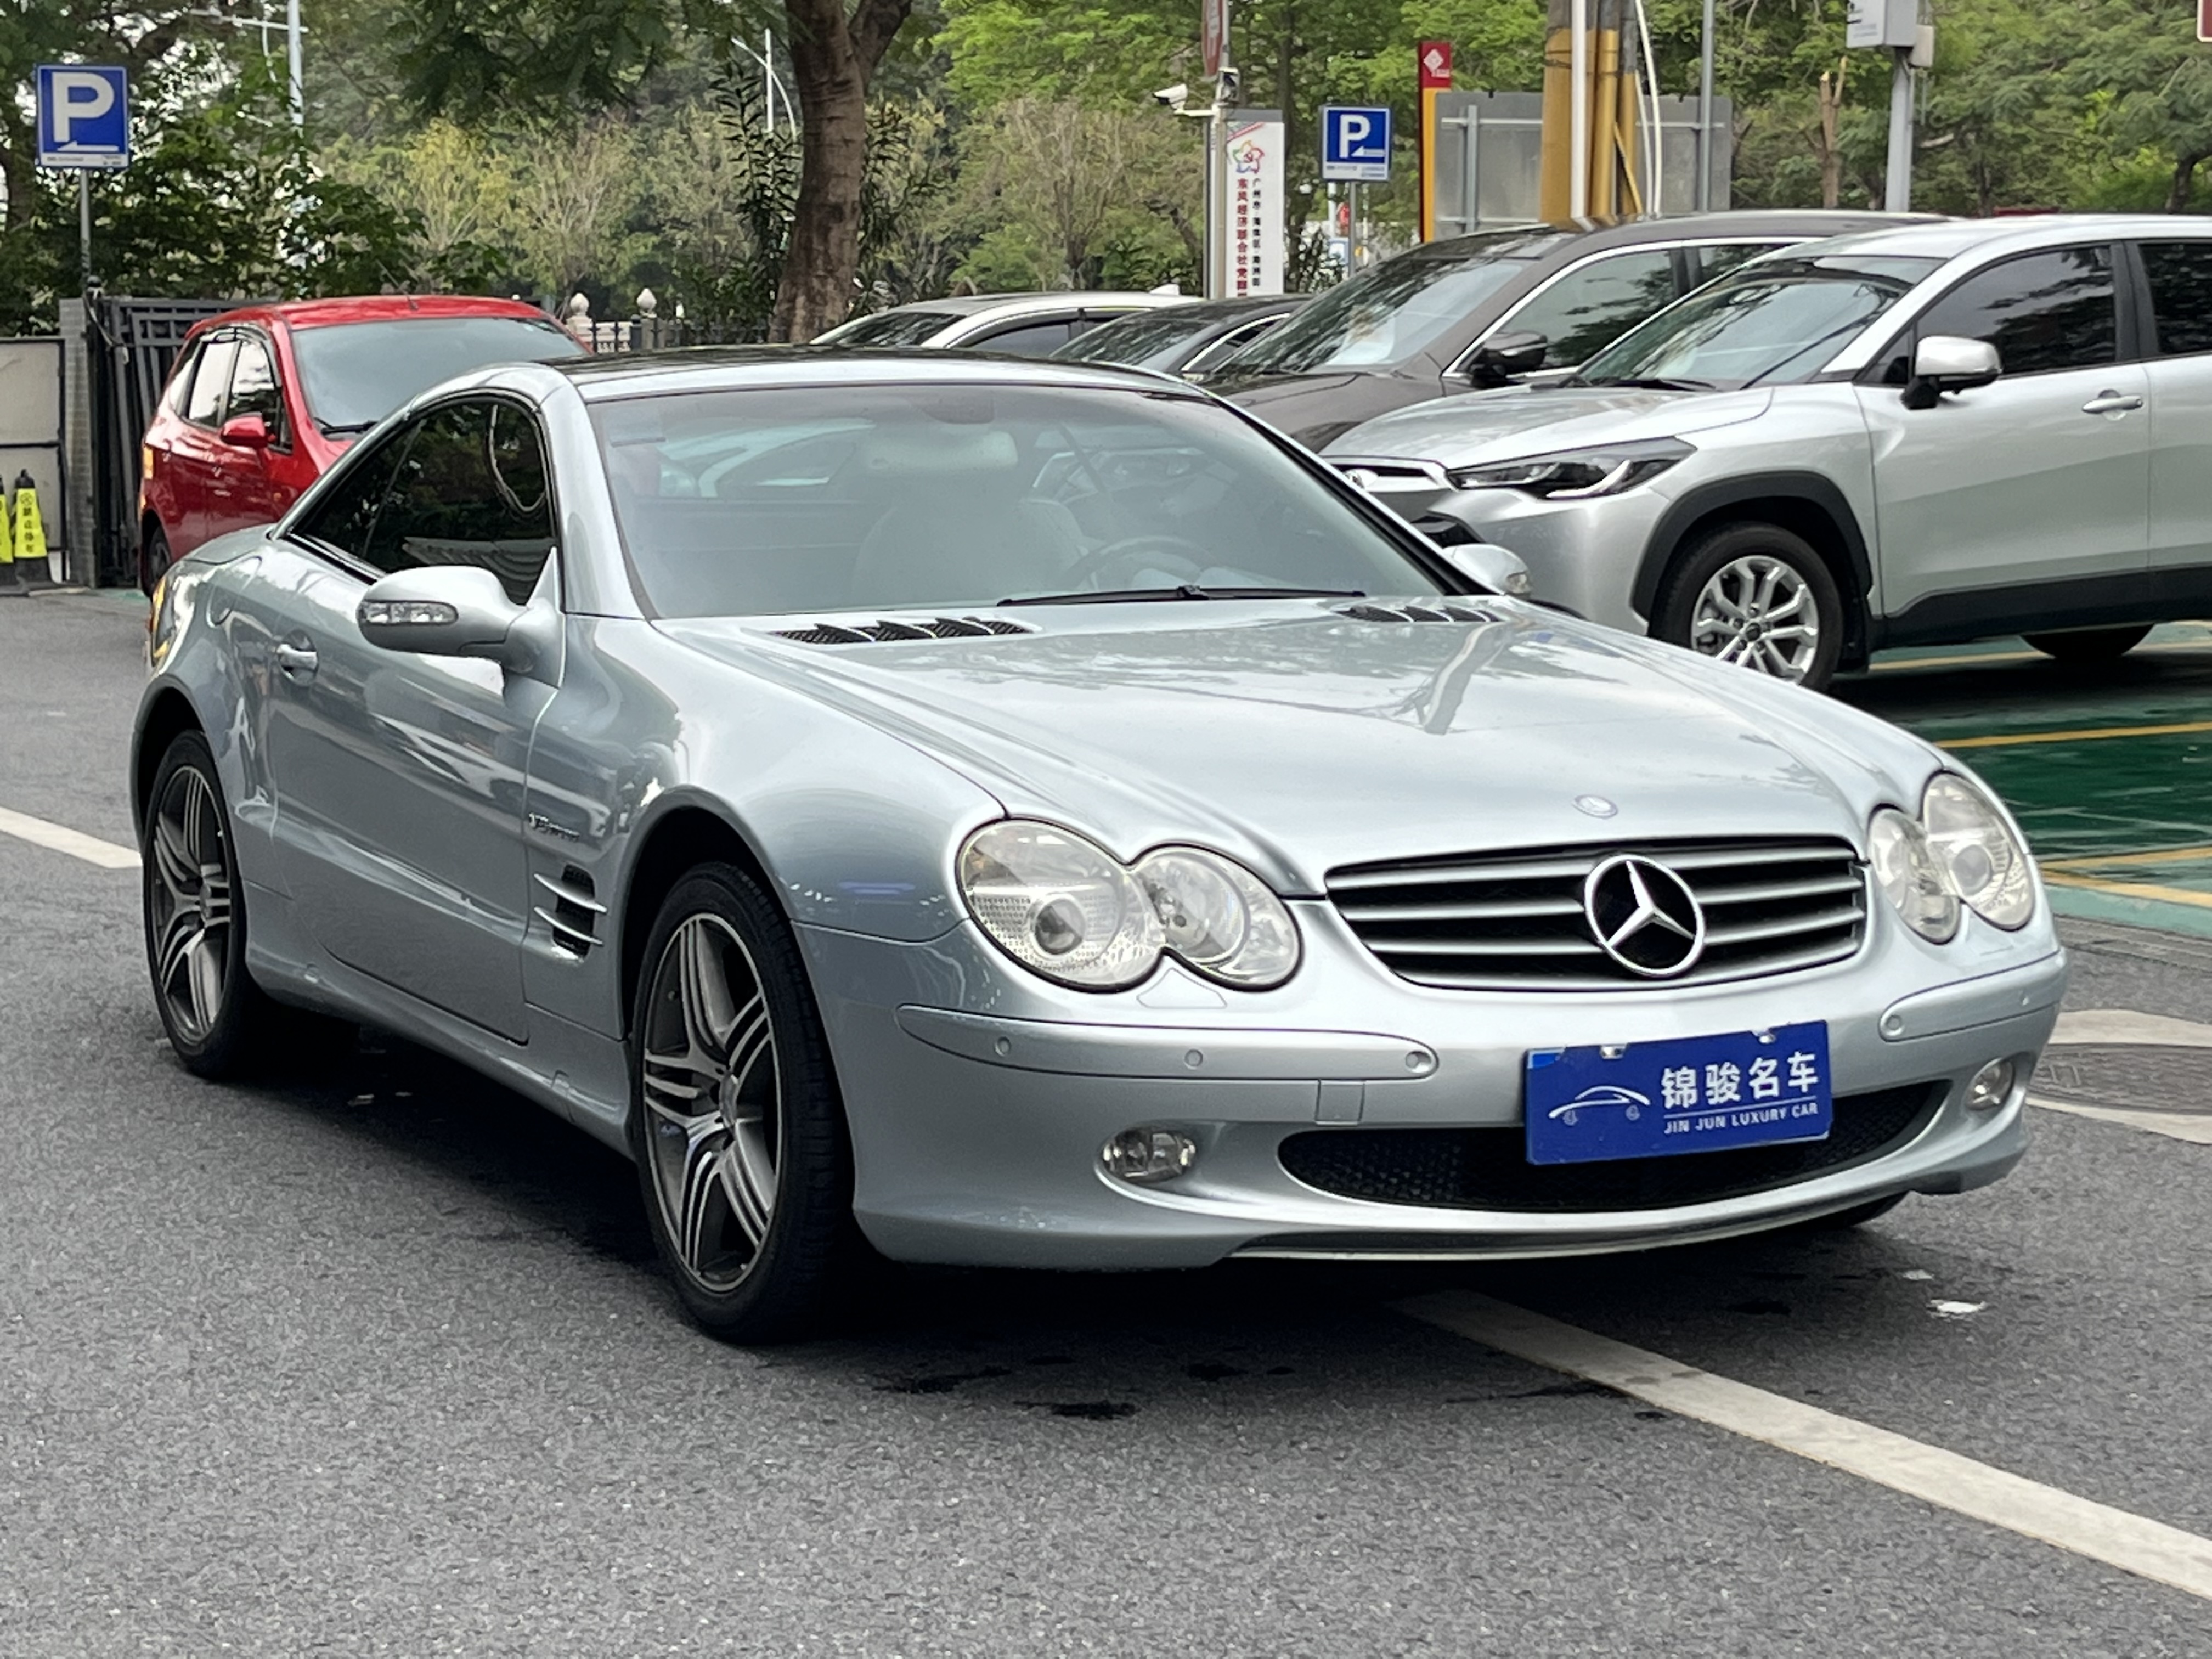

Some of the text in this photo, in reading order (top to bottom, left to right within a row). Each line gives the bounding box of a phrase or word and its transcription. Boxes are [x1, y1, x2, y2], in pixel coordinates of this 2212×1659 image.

[52, 72, 114, 142] P
[1339, 114, 1371, 158] P
[1661, 1051, 1818, 1108] 锦骏名车
[1664, 1103, 1818, 1134] JIN JUN LUXURY CAR
